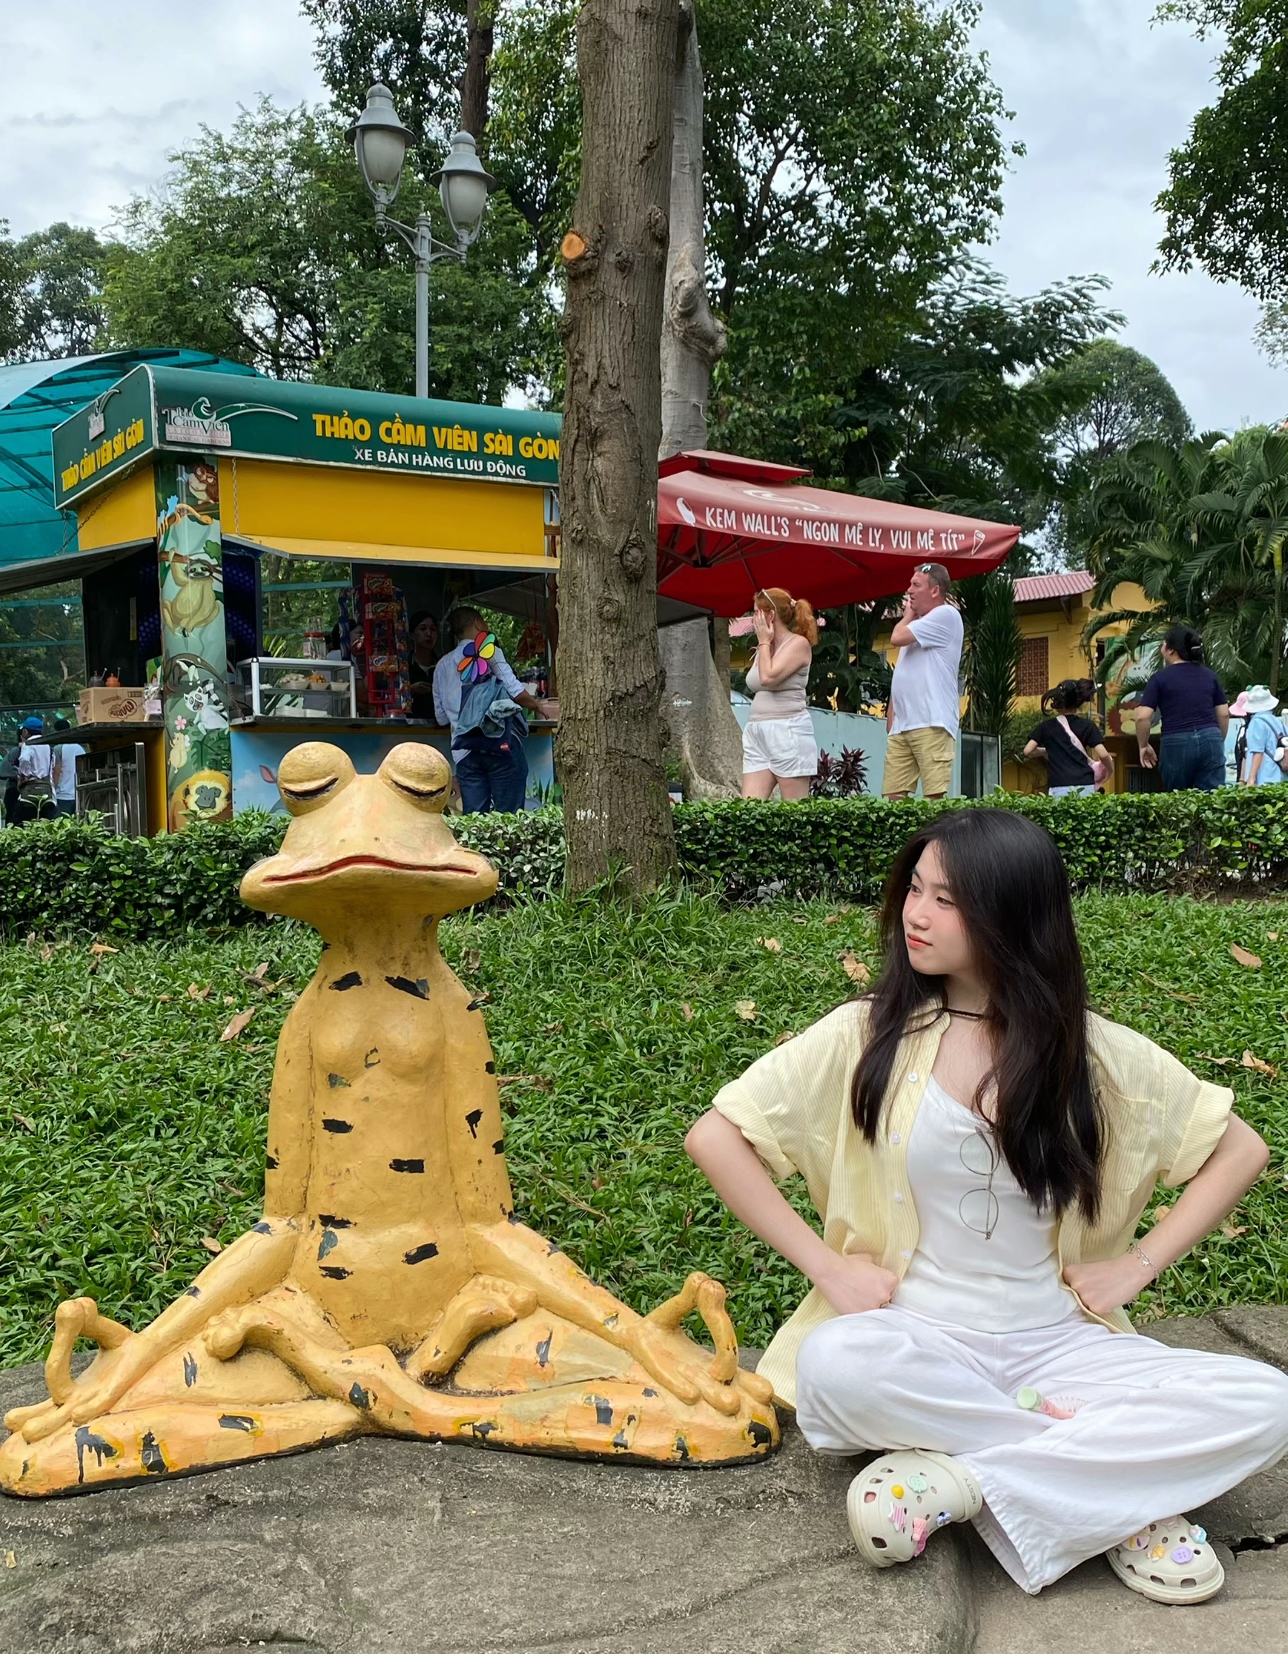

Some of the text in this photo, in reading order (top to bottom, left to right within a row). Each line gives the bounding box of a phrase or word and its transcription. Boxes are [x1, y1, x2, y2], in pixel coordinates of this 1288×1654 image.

[312, 410, 560, 460] THẢO CẦM VIÊN SÀI GÒN
[354, 448, 373, 461] XE
[412, 451, 454, 469] HÀNG
[456, 457, 483, 472] LƯU
[486, 460, 526, 477] ĐỘNG
[705, 506, 966, 551] KEM WALL’S “NGON MÊ LY, VUI MÊ TÍT”
